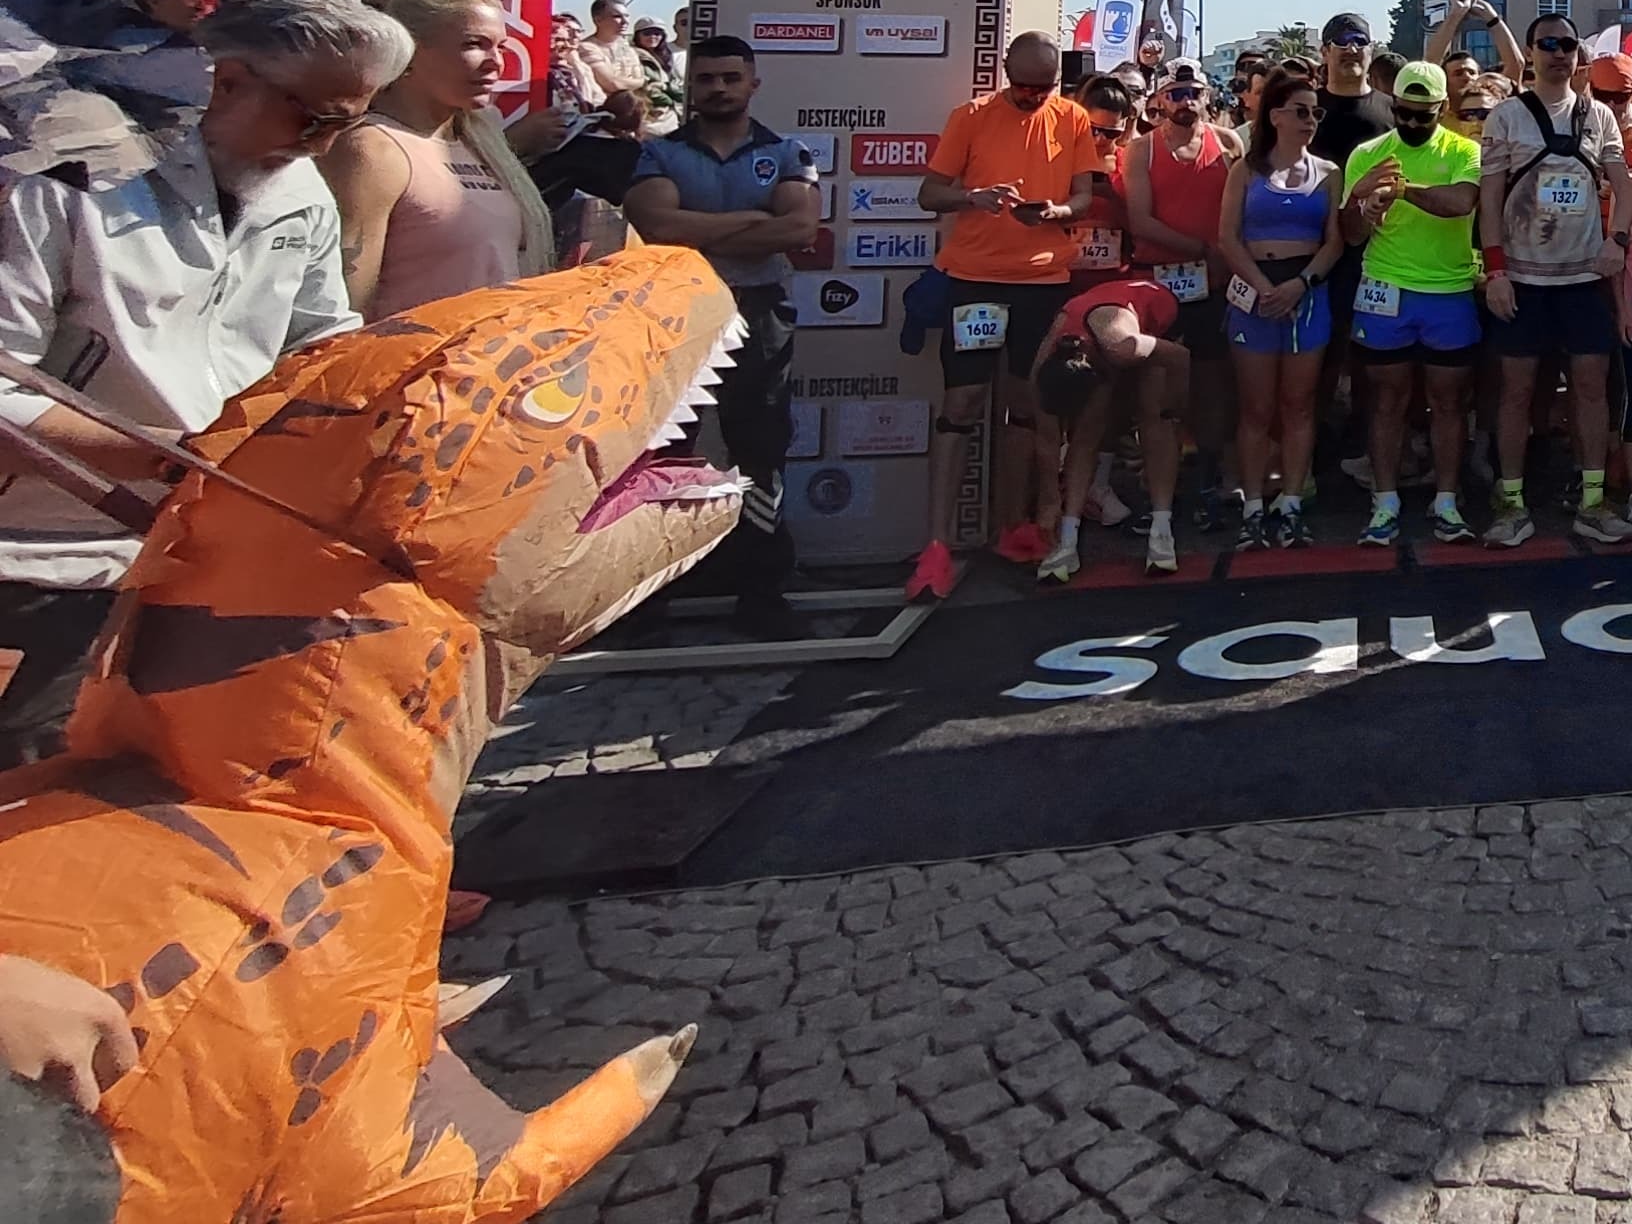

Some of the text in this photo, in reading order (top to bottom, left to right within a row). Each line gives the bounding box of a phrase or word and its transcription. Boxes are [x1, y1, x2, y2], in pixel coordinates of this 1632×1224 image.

[756, 26, 833, 39] DARDANEL
[798, 106, 886, 131] DESTEKÇİLER
[863, 141, 927, 165] ZÜBER
[1552, 191, 1578, 203] 1327
[856, 235, 926, 258] Erikli
[1081, 246, 1109, 258] 1473
[1168, 280, 1196, 291] 1474
[1363, 289, 1386, 303] 1434
[966, 323, 997, 336] 1602
